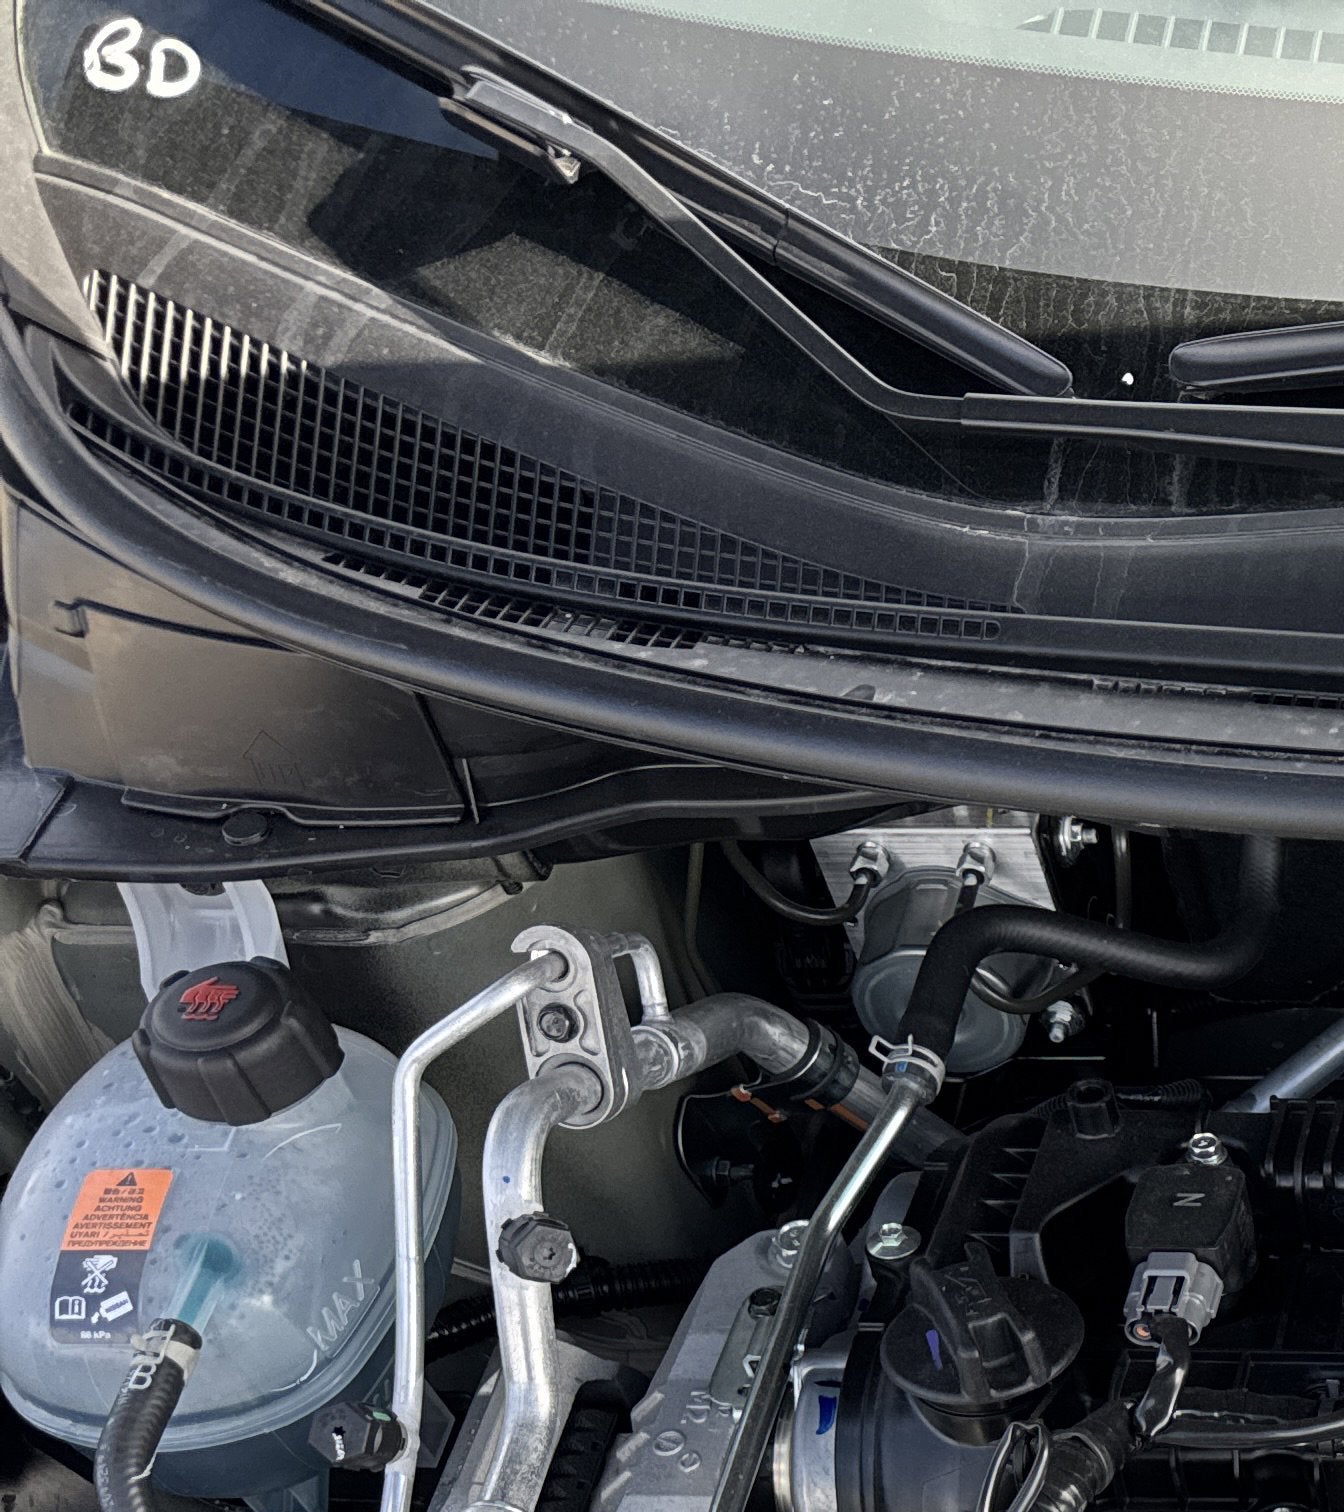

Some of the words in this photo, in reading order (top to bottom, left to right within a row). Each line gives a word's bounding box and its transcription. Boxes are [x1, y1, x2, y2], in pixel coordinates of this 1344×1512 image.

[83, 19, 201, 98] BD
[72, 1222, 152, 1230] AVERTISSEMENT
[306, 1259, 375, 1351] MAX
[128, 1364, 157, 1389] B
